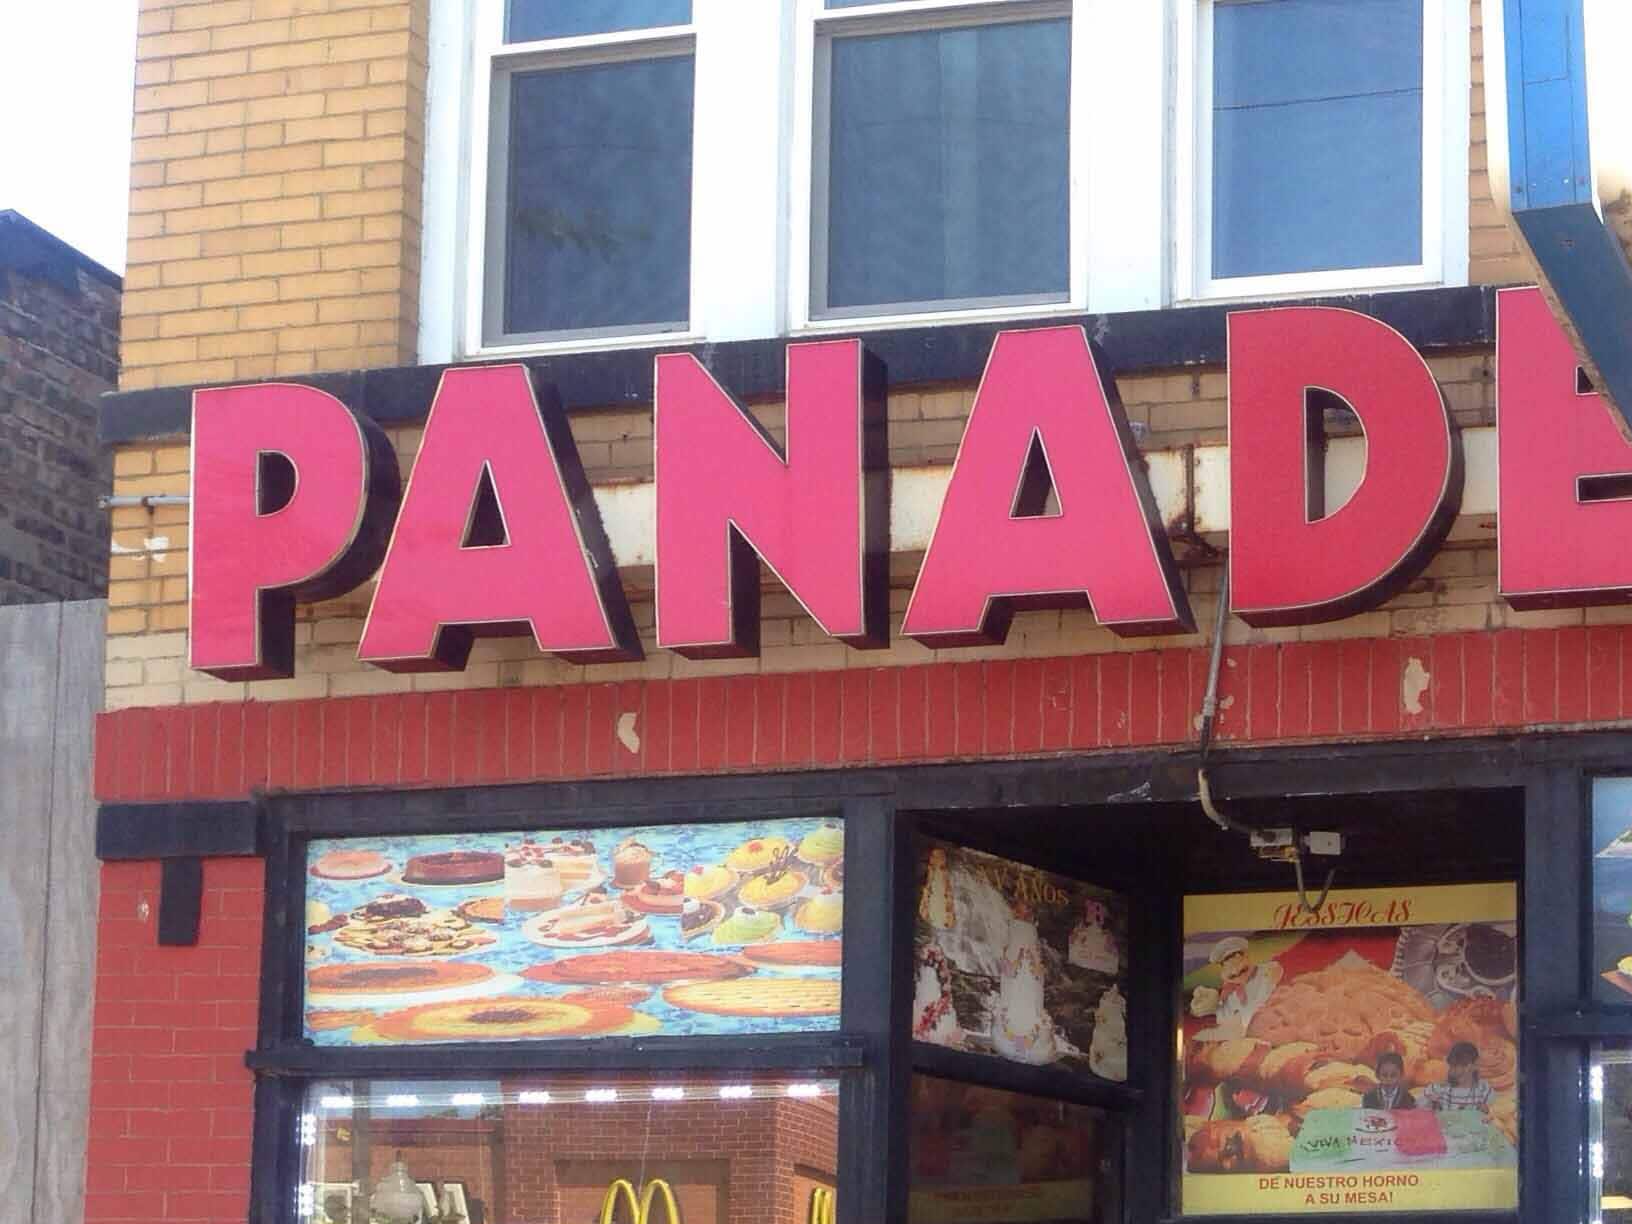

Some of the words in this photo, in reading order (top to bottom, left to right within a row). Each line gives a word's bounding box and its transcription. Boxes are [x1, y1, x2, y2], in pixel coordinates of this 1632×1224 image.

[1259, 1178, 1280, 1189] DE
[1284, 1176, 1358, 1189] NUESTRO
[1362, 1175, 1419, 1188] HORNO
[1305, 1193, 1315, 1205] A
[1319, 1193, 1340, 1205] SU
[1344, 1191, 1393, 1204] MESA!
